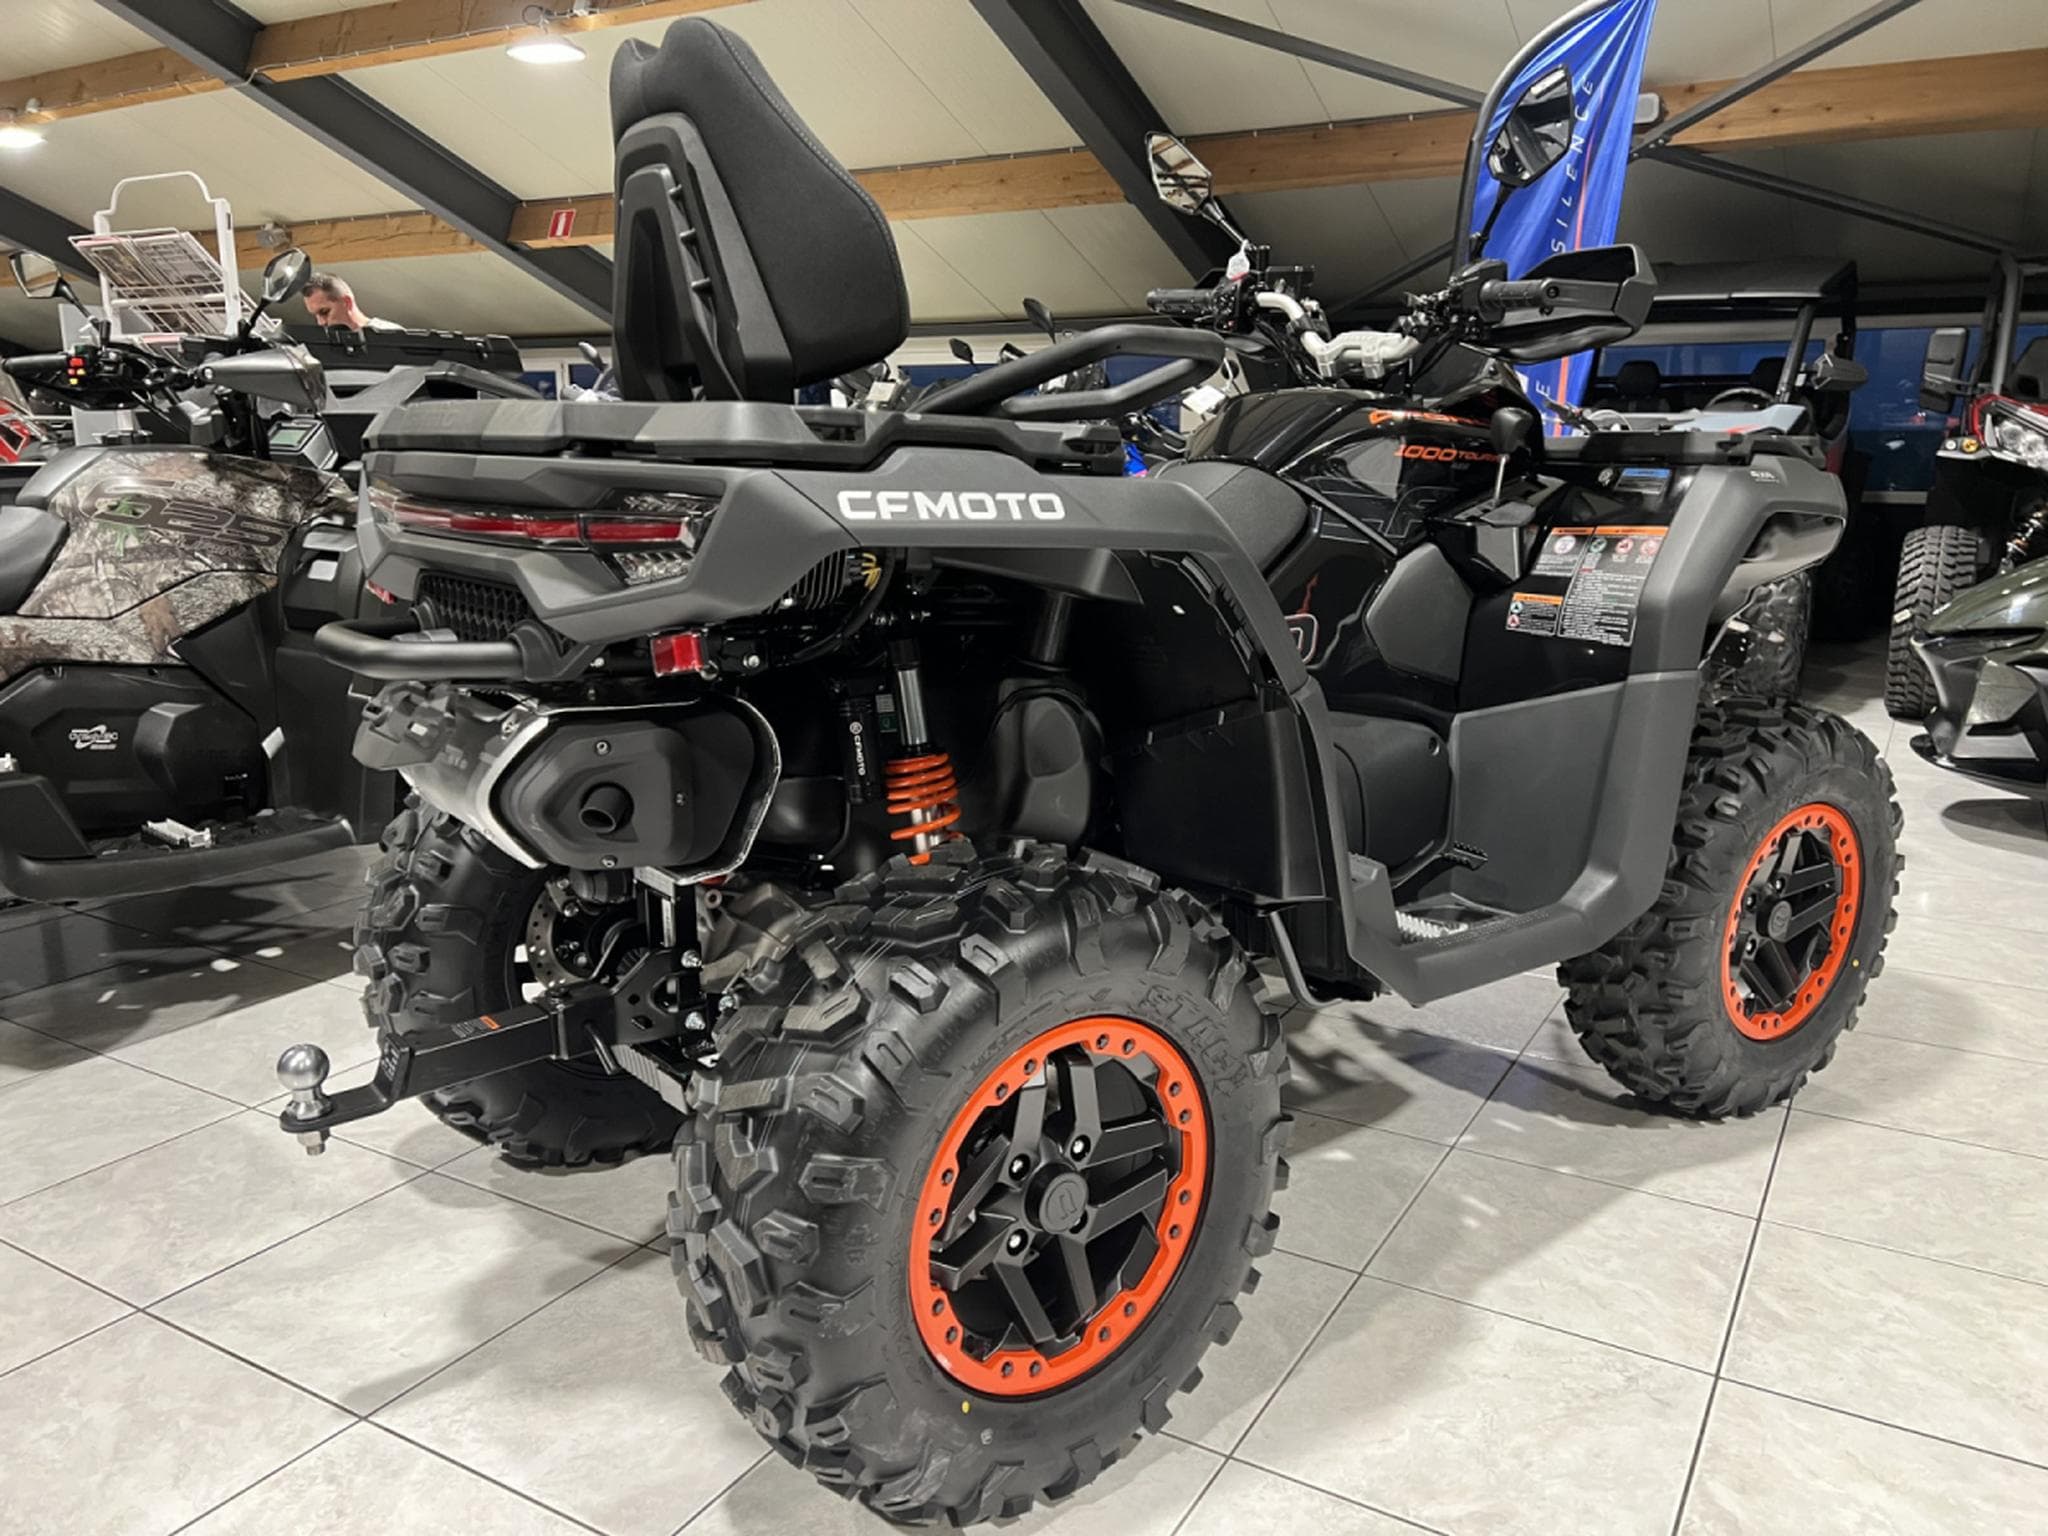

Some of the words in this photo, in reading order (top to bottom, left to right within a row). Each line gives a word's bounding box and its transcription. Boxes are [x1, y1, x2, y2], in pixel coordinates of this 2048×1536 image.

[1552, 77, 1595, 253] SILENCE
[1394, 444, 1457, 462] 1000
[837, 490, 1066, 521] CFMOTO
